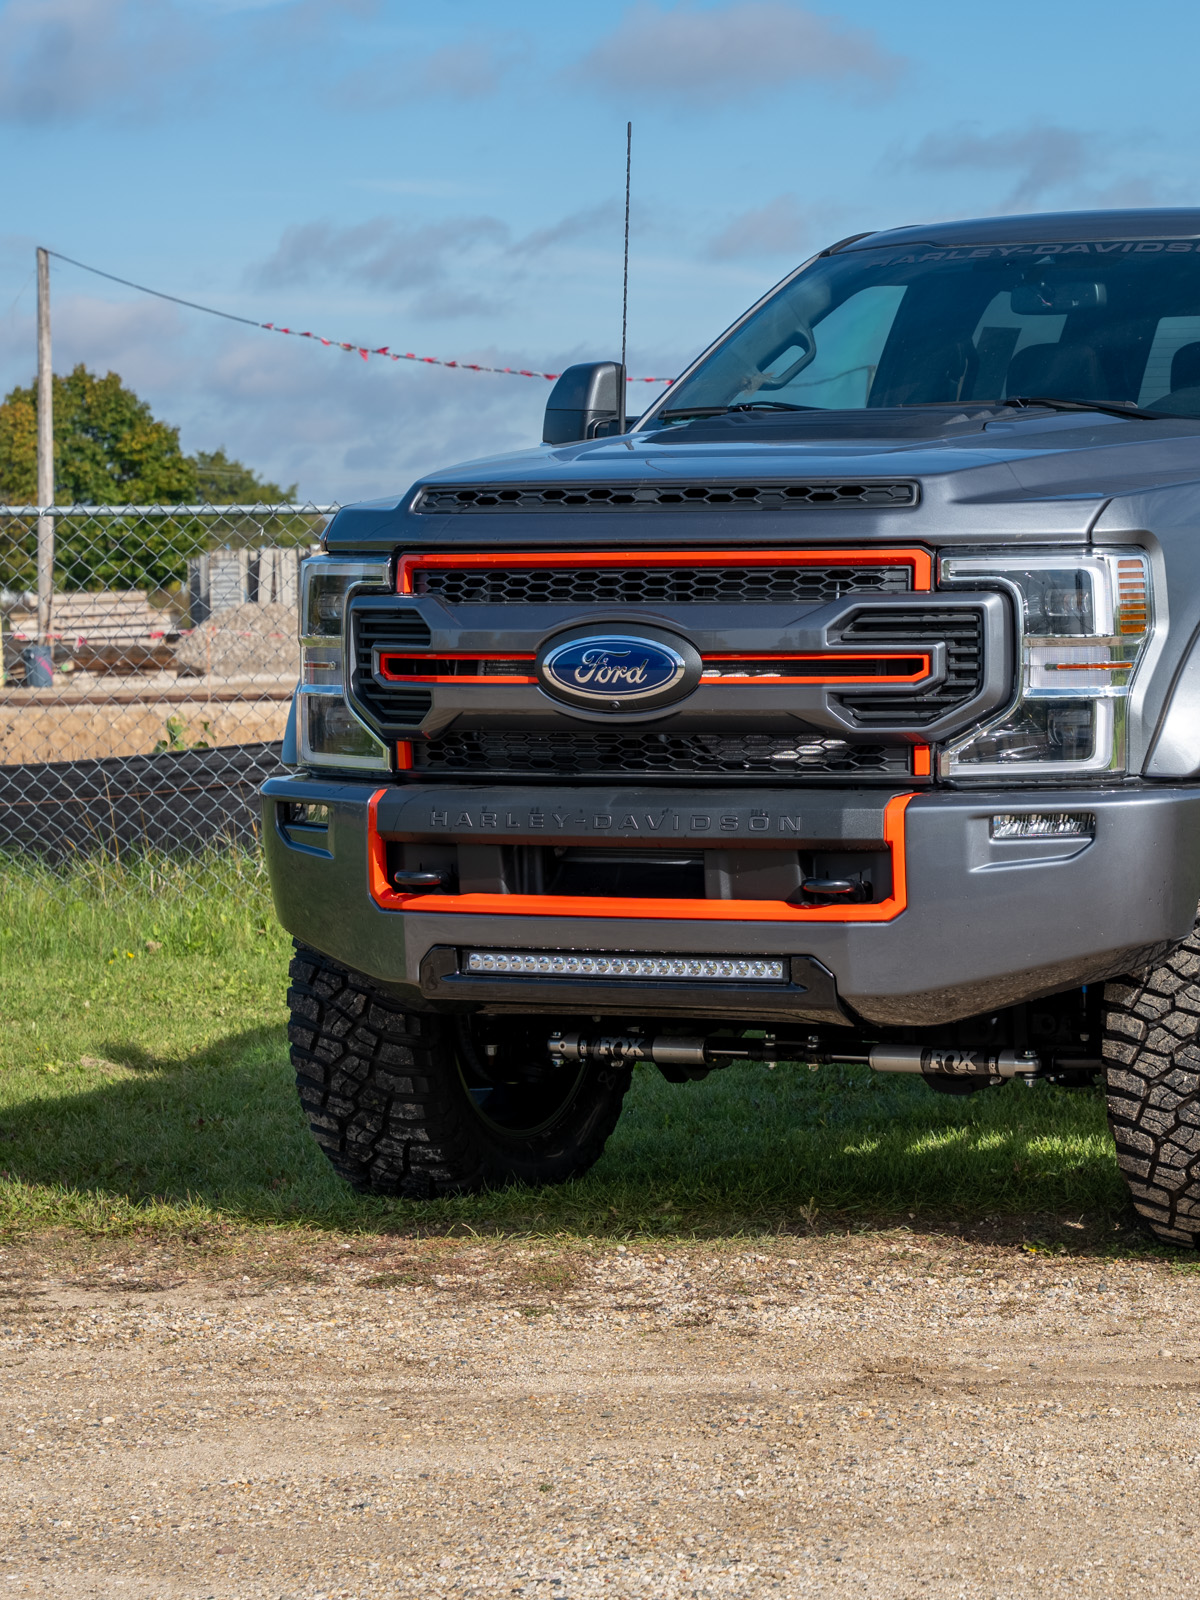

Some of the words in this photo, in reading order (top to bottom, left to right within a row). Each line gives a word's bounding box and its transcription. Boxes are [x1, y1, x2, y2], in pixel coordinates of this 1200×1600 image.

[574, 648, 649, 684] Ford
[429, 810, 803, 832] HARLEY-DAVIDSON
[599, 1036, 646, 1058] FOX
[929, 1049, 978, 1076] FOX
